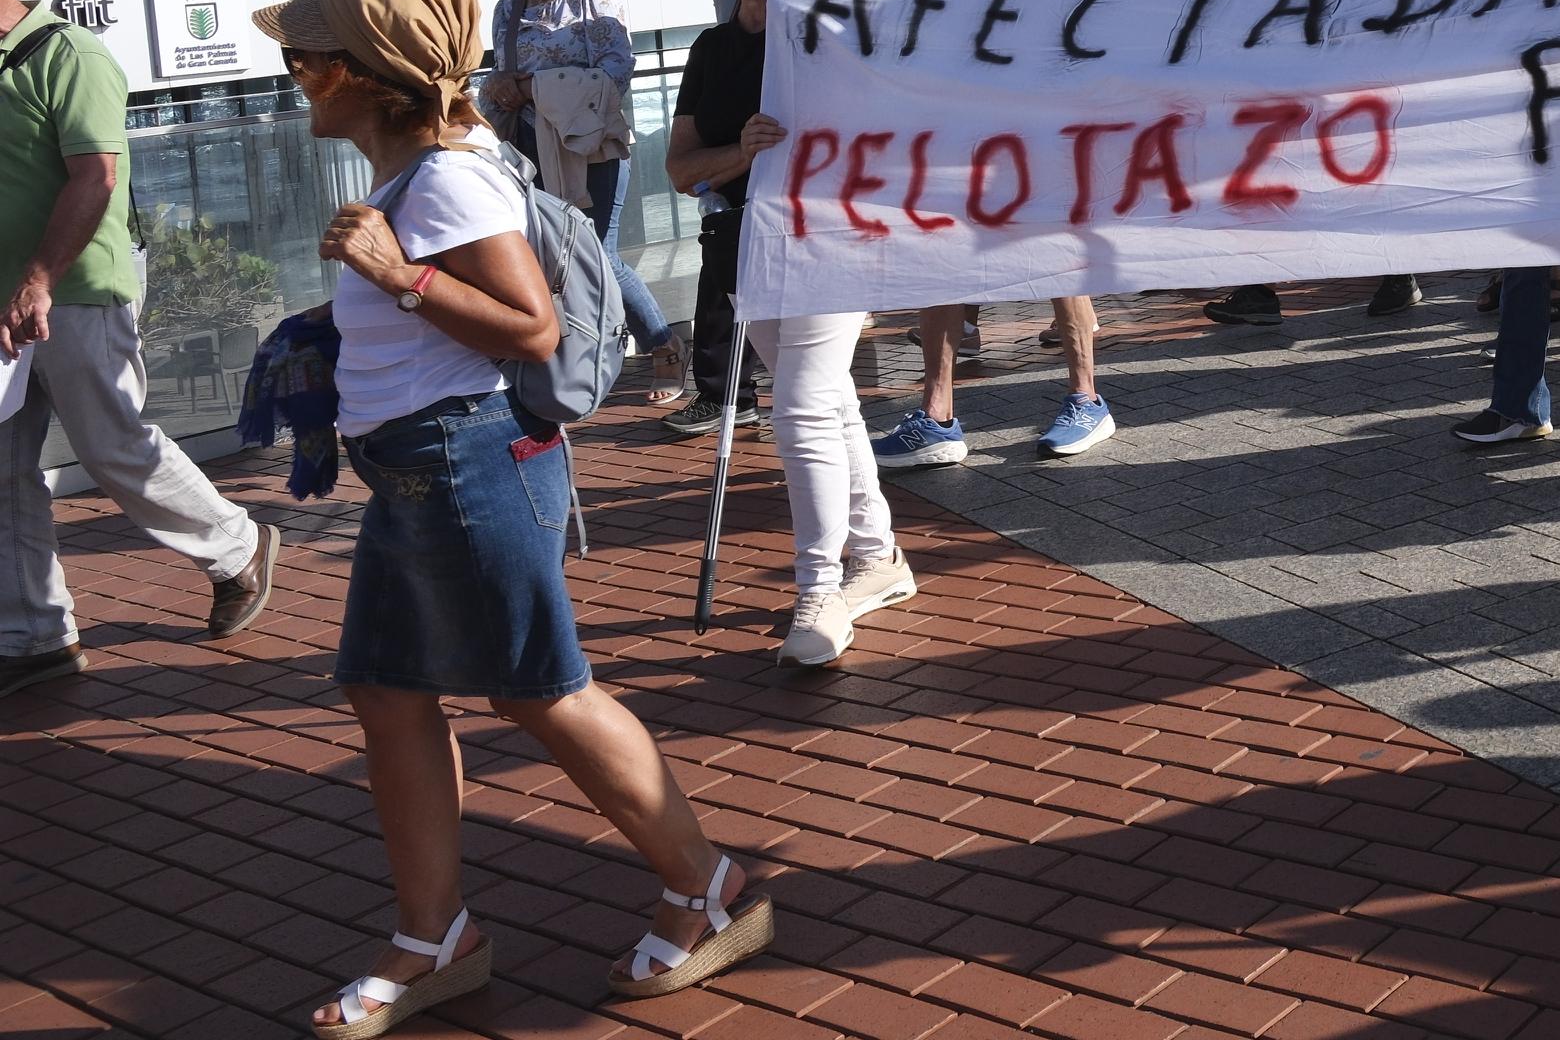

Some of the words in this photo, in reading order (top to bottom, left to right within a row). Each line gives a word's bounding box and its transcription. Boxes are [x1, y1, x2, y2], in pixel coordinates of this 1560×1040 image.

[175, 42, 236, 54] Ayuntamiento
[208, 50, 237, 58] Palmas
[208, 57, 238, 66] Canaria
[785, 94, 1394, 240] PELOTAZO
